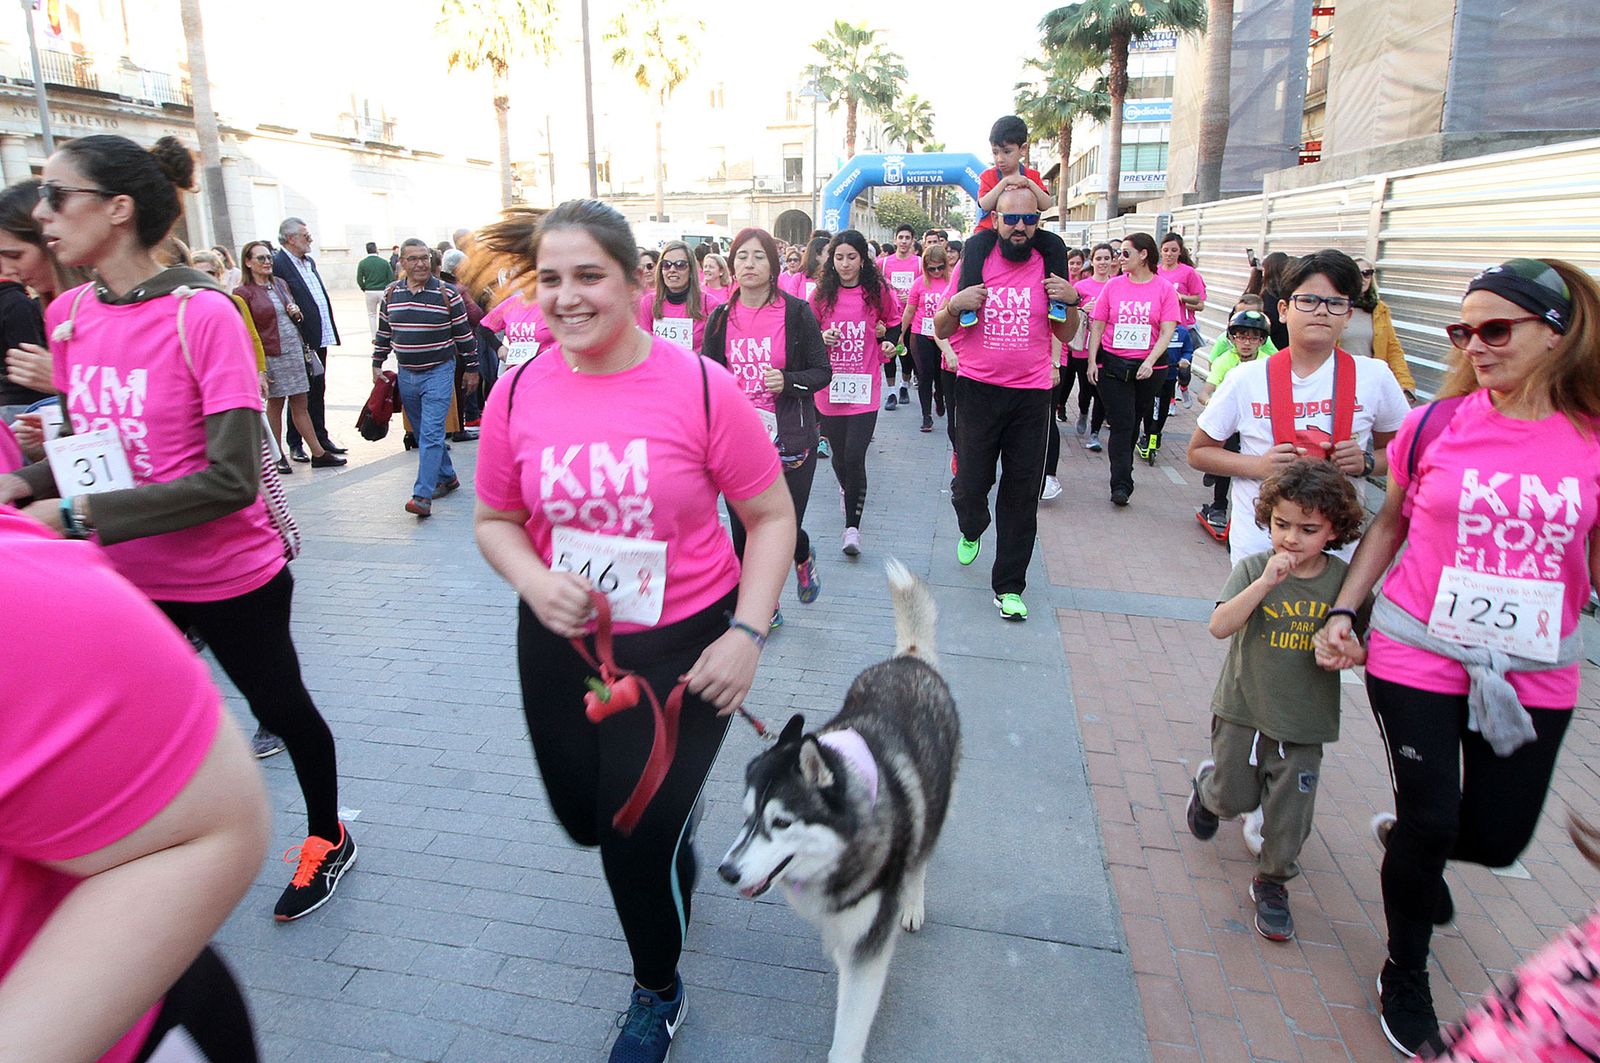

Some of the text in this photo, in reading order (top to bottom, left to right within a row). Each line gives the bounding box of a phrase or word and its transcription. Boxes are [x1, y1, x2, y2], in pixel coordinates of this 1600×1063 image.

[12, 106, 120, 129] AYUTAMIENTO
[833, 168, 862, 197] DEPORTES
[906, 175, 944, 183] HUELVA
[986, 287, 1031, 309] KM
[1118, 301, 1152, 315] KM
[983, 308, 1031, 325] POR
[1118, 315, 1150, 325] POR
[510, 321, 537, 337] KM
[655, 325, 678, 340] 645
[830, 321, 866, 340] KM
[983, 324, 1029, 337] ELLAS
[1115, 330, 1138, 342] 676
[730, 337, 772, 363] KM
[830, 352, 864, 363] ELLAS
[68, 363, 149, 418] KM
[832, 381, 857, 394] 413
[73, 454, 114, 487] 31
[540, 437, 650, 500] KM
[1458, 467, 1582, 526] KM
[542, 495, 655, 532] POR
[1456, 511, 1576, 556] POR
[1455, 545, 1564, 580] ELLAS
[1447, 591, 1520, 630] 125
[1290, 621, 1315, 632] PARA
